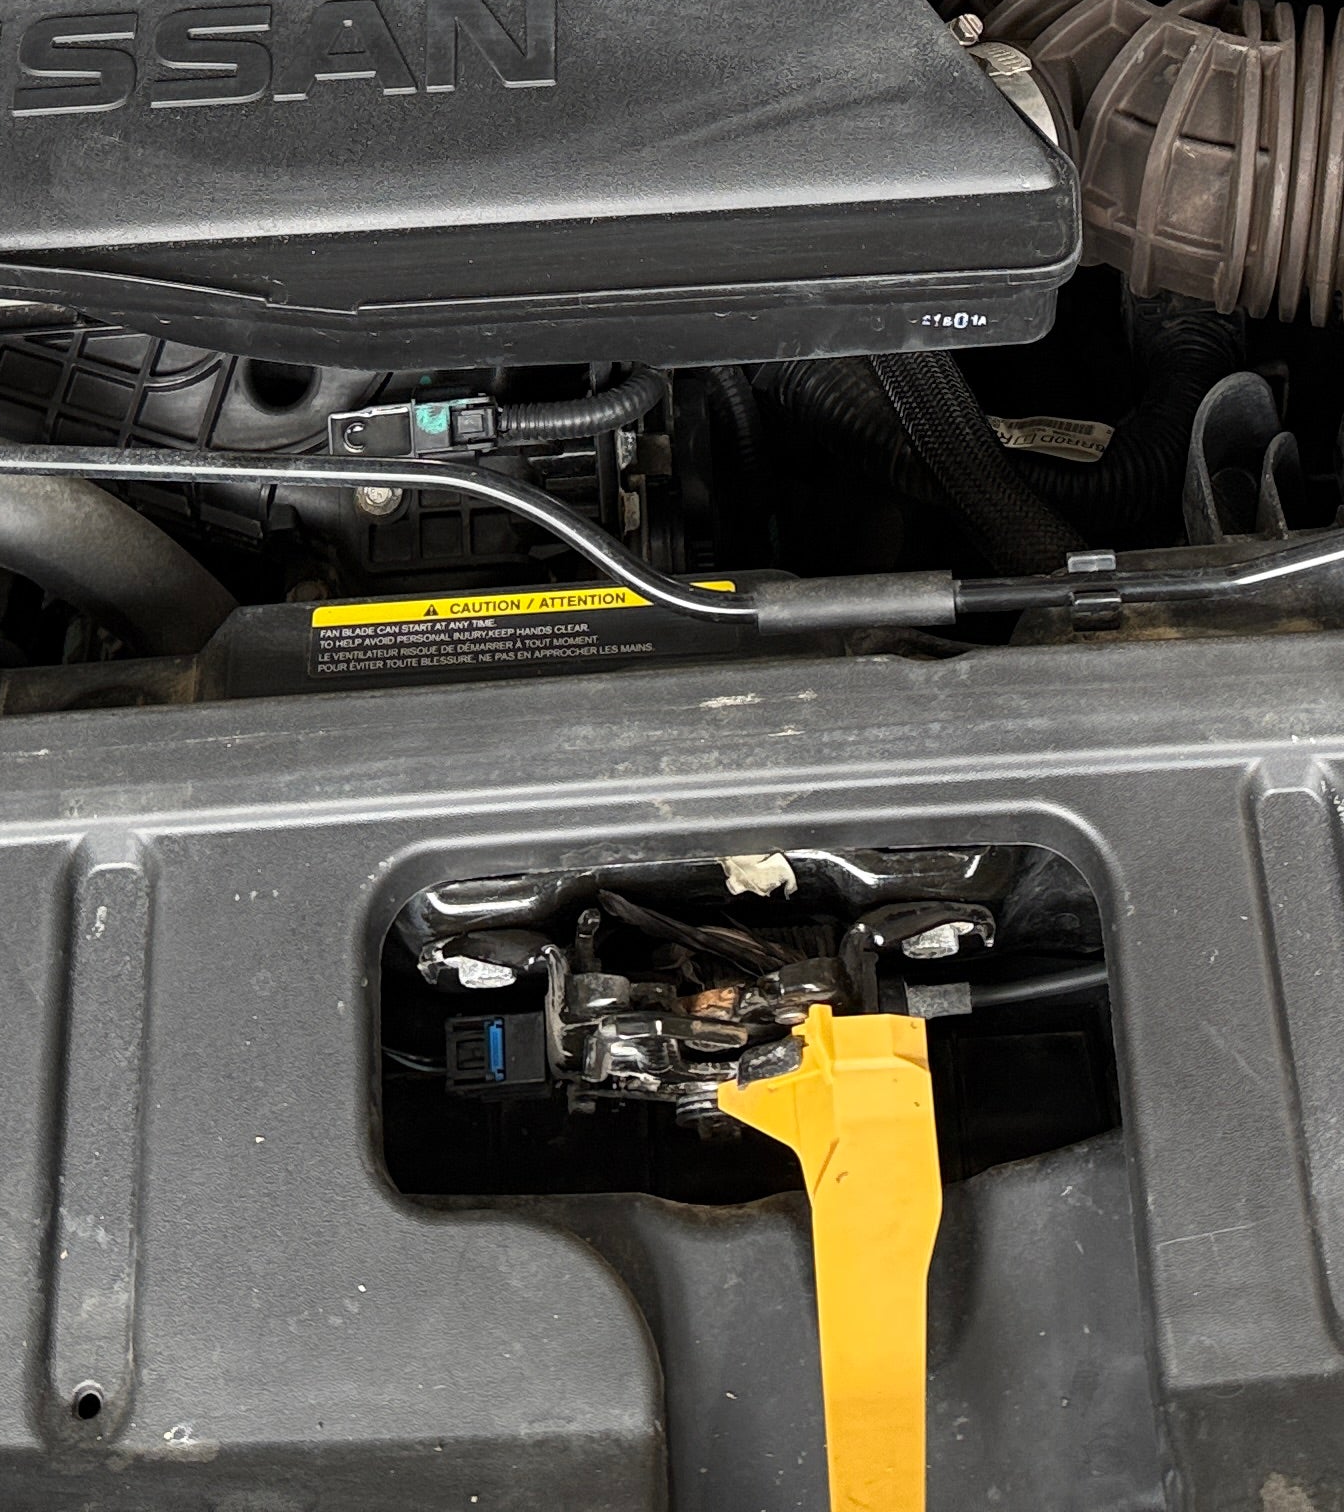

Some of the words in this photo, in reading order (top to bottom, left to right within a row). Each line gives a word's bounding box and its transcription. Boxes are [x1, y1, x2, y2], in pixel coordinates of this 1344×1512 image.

[450, 599, 521, 614] CAUTION
[526, 598, 535, 610] /
[539, 592, 626, 609] ATTENTION
[320, 629, 340, 638] FAN
[342, 627, 375, 636] BLADE
[377, 625, 400, 634] CAN
[401, 623, 432, 633] START
[434, 622, 447, 631] AT
[449, 621, 469, 629] ANY
[320, 640, 333, 649] TO
[336, 639, 362, 648] HELP
[364, 636, 393, 646] AVOID
[397, 633, 450, 643] PERSONAL
[516, 626, 552, 635] HANDS
[318, 662, 347, 673] POUR
[350, 660, 384, 670] ÉVITER
[386, 657, 419, 668] TOUTE
[479, 652, 493, 662] NE
[495, 651, 515, 661] PAS
[517, 650, 532, 660] EN
[533, 645, 597, 658] APPROCHER
[599, 644, 619, 654] LES
[319, 653, 330, 662] LE
[333, 648, 398, 660] VENTILATEUR
[400, 645, 439, 656] RISQUE
[441, 643, 455, 653] DE
[457, 640, 513, 653] DÉMARRER
[515, 638, 523, 648] À
[524, 637, 551, 647] TOUT
